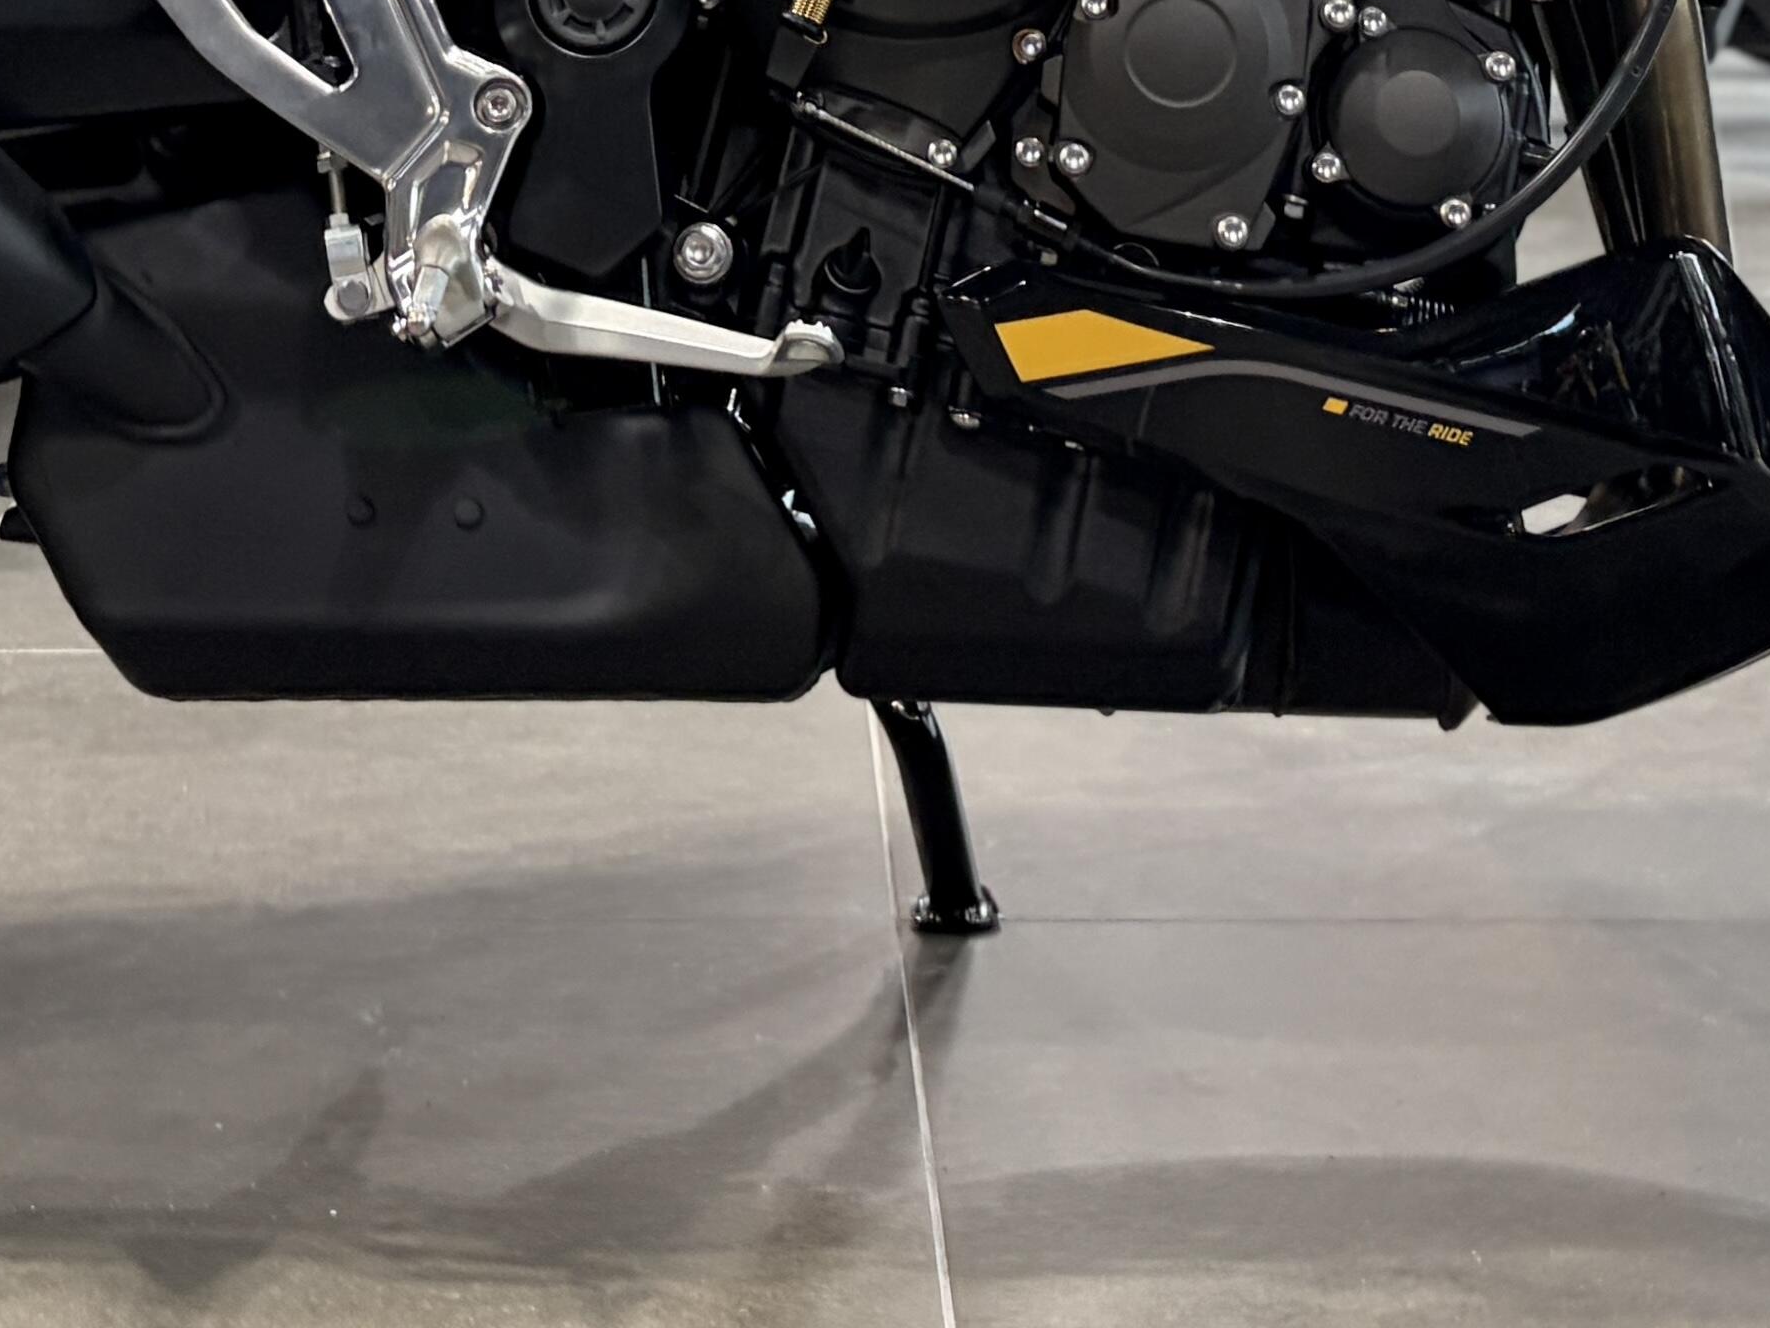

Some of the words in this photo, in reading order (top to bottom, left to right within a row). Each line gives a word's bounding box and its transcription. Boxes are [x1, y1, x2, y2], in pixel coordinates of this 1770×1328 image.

[1348, 403, 1388, 425] FOR
[1392, 413, 1427, 436] THE
[1428, 422, 1473, 446] RIDE
